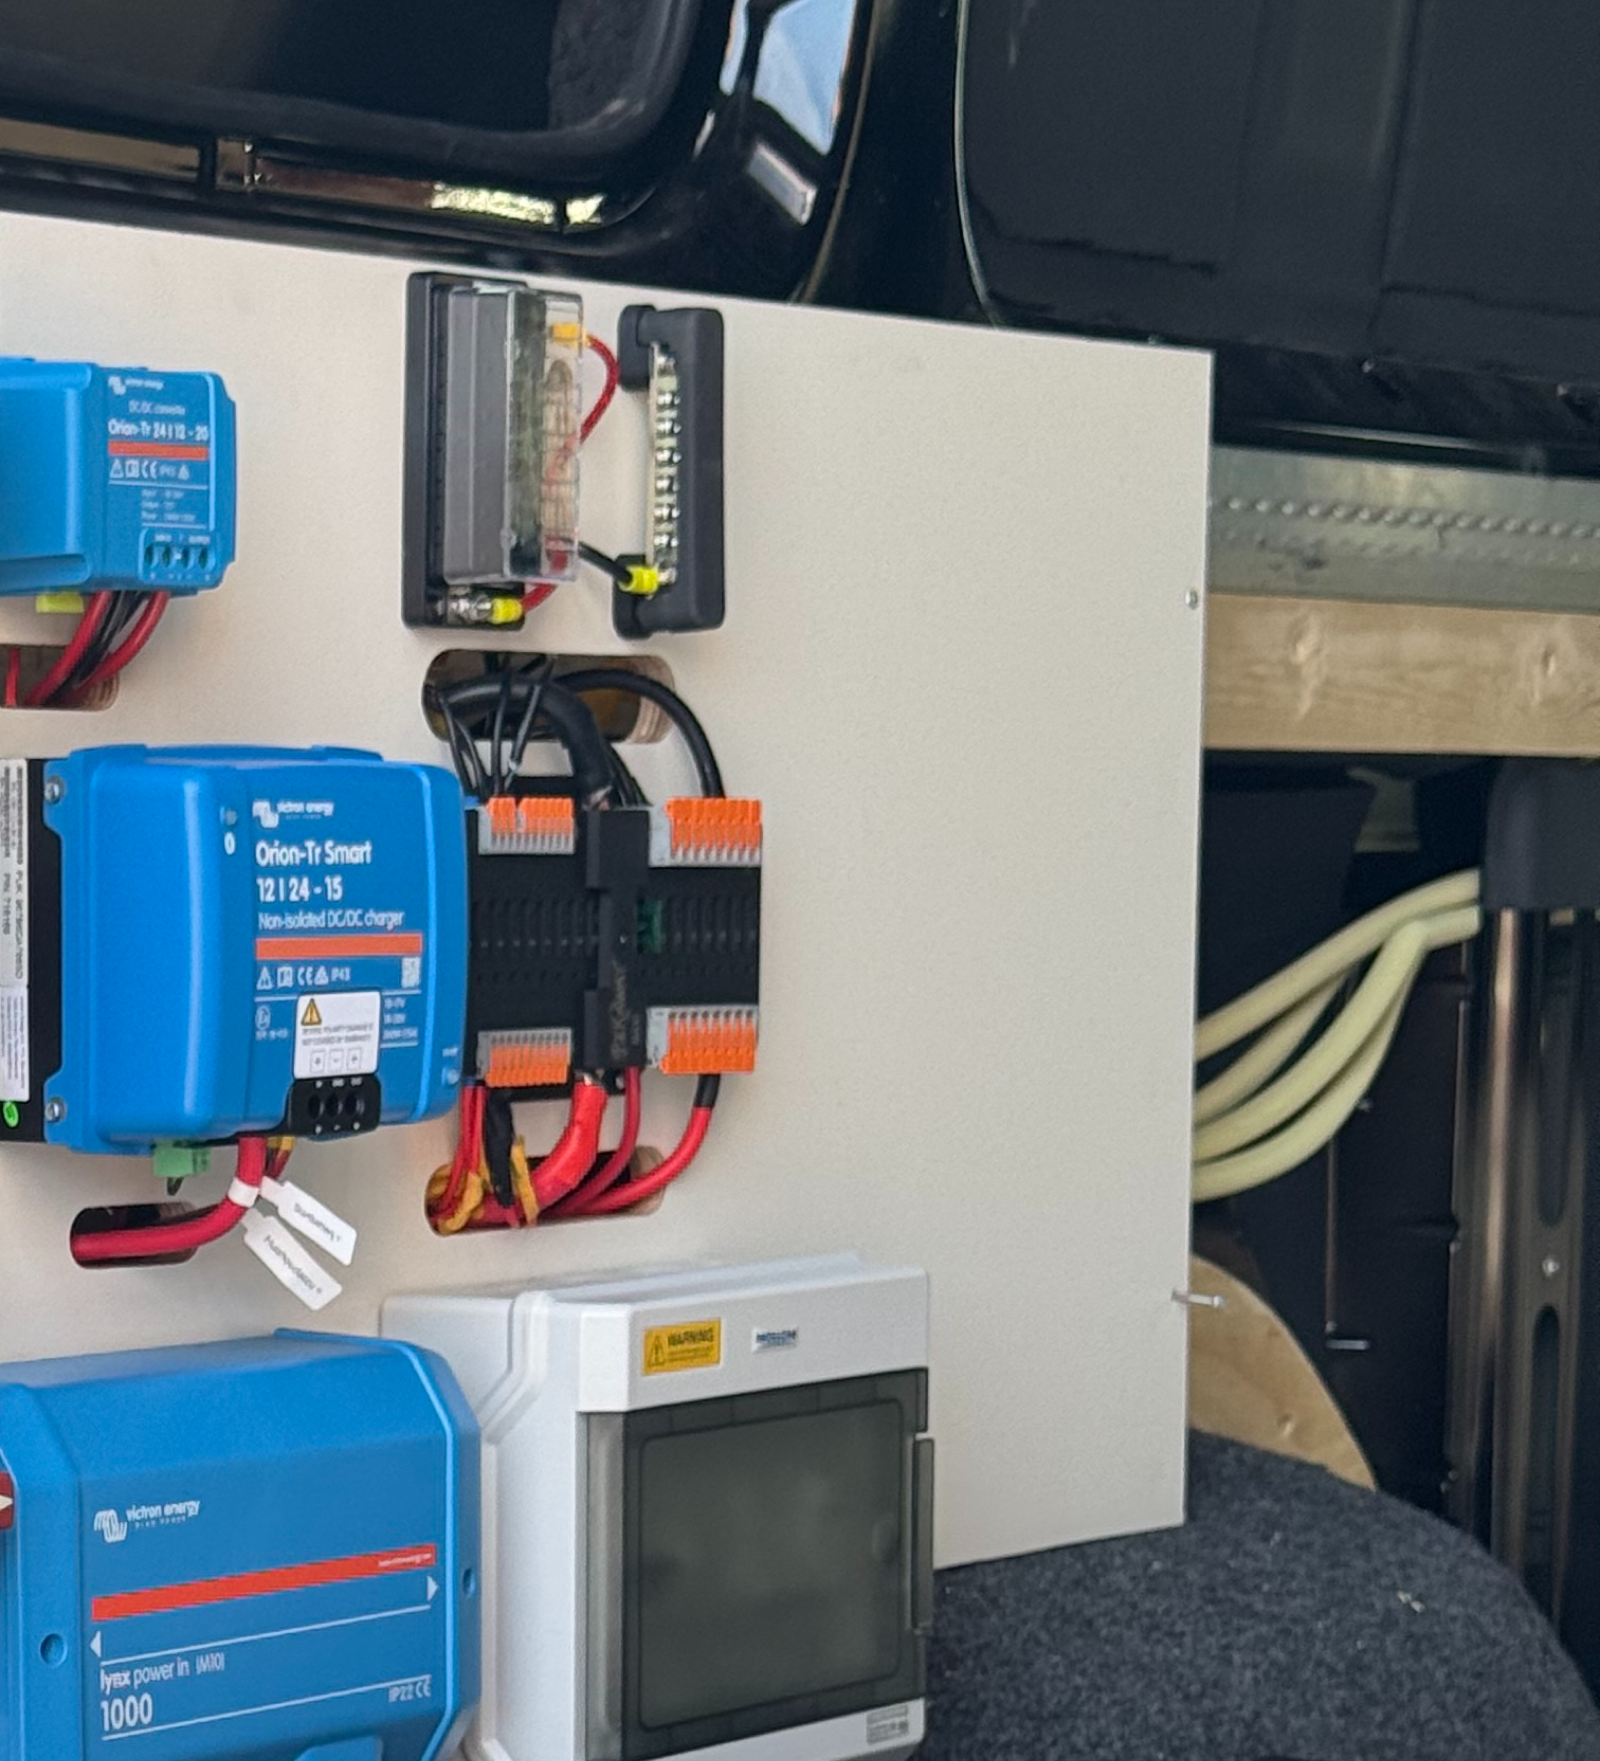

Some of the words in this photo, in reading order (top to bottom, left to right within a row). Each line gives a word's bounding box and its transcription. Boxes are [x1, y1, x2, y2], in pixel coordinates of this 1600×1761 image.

[256, 840, 321, 867] Orion-Tr
[324, 840, 373, 865] Smart
[257, 876, 276, 902] 12
[288, 876, 310, 902] 24
[324, 875, 343, 900] 15
[259, 911, 326, 930] Non-isolated
[327, 909, 363, 928] DC/DC
[364, 909, 405, 931] charger
[126, 1504, 162, 1521] victron
[163, 1500, 200, 1517] energy
[100, 1668, 131, 1694] lynx
[133, 1661, 175, 1689] power
[177, 1656, 189, 1677] in
[101, 1692, 153, 1732] 1000
